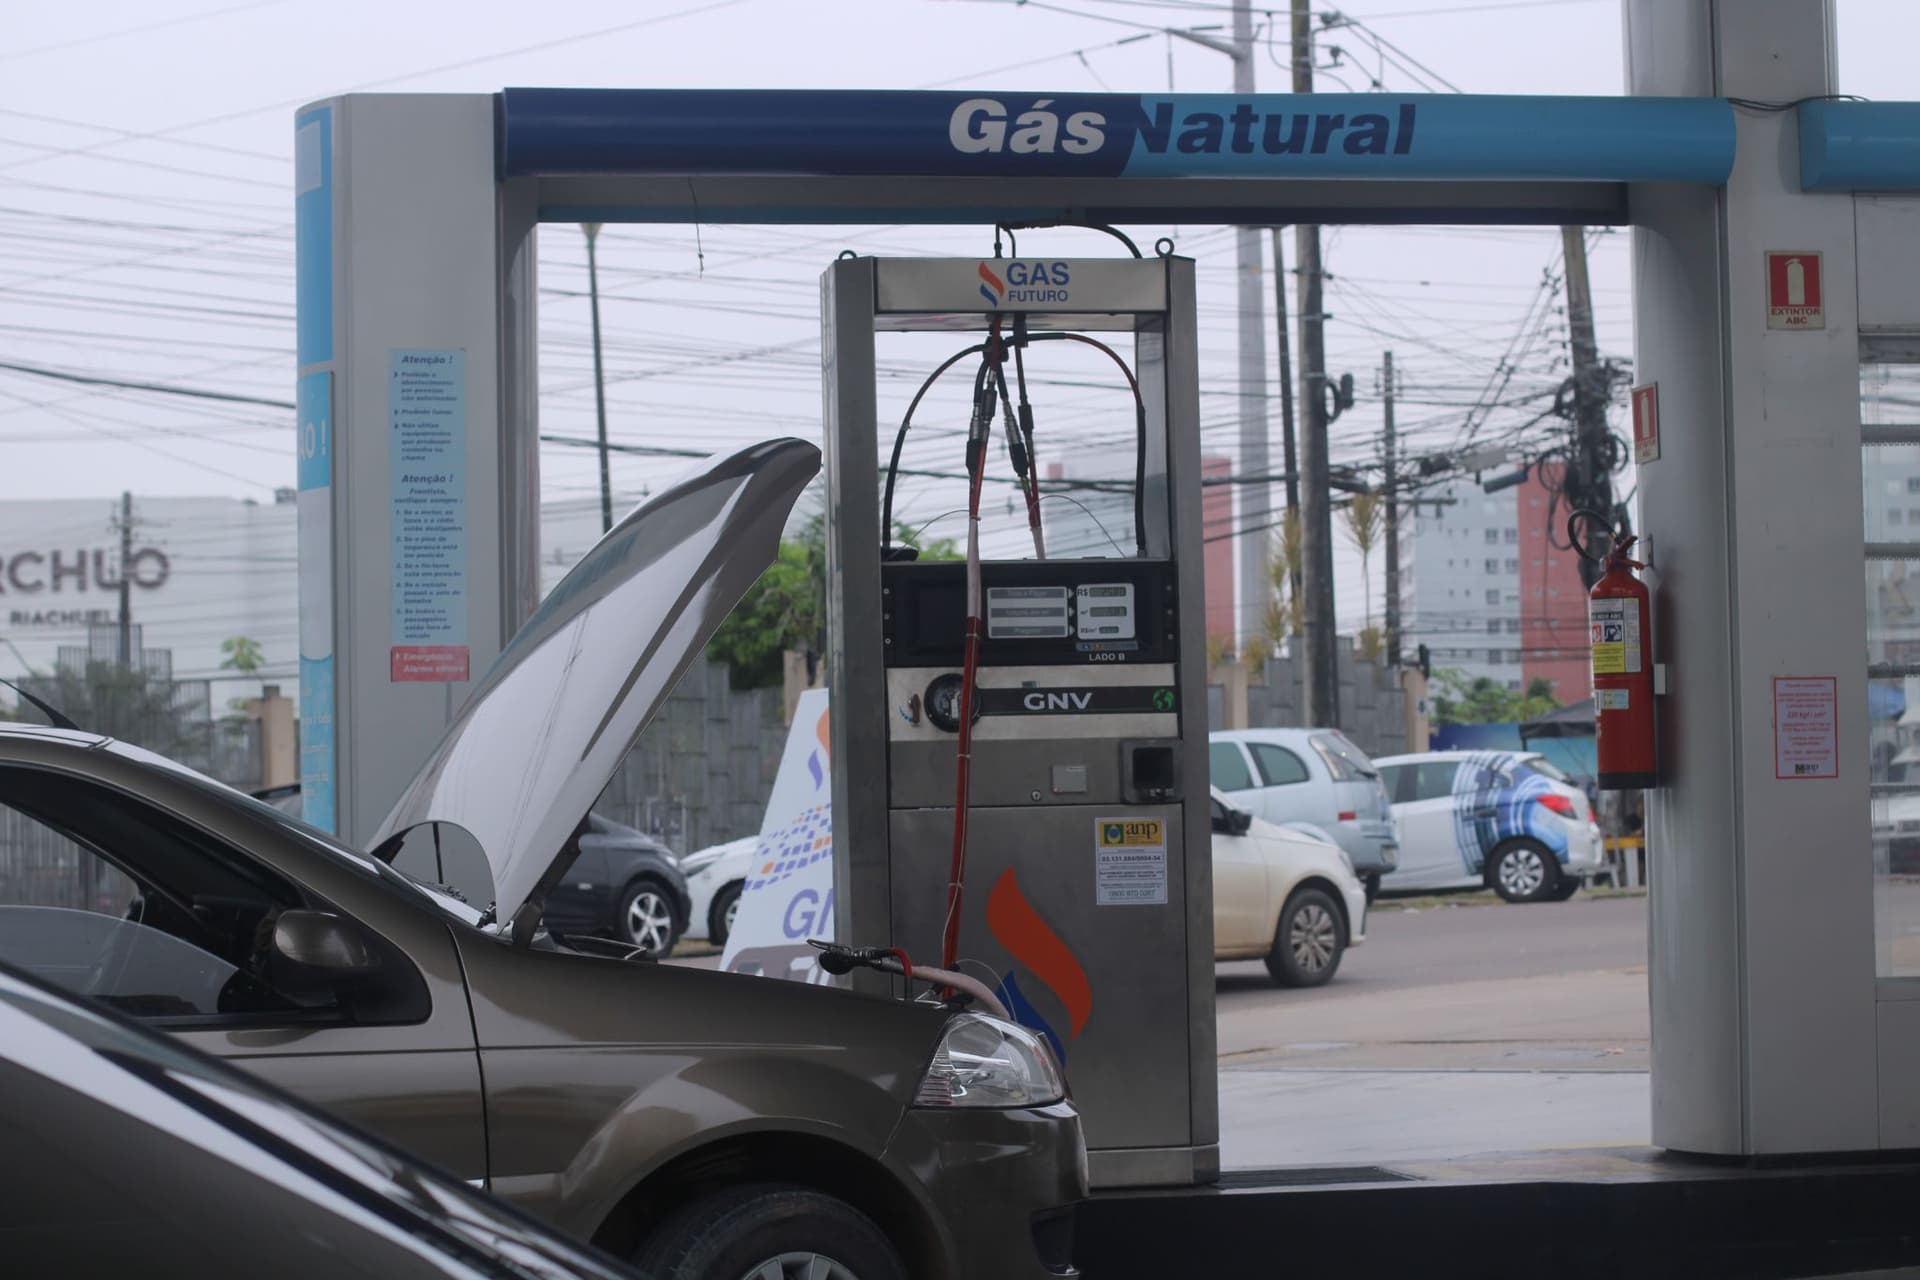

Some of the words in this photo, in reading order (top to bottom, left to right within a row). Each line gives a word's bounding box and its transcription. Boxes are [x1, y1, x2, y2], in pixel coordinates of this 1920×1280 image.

[949, 98, 1106, 155] Gás
[1131, 102, 1417, 155] Natural
[1006, 262, 1070, 286] GAS
[1008, 290, 1069, 302] FUTURO
[1770, 307, 1821, 316] EXTINTOR
[1785, 316, 1808, 325] ABC
[401, 355, 446, 366] Atenção
[401, 474, 446, 485] Atenção
[0, 548, 170, 594] CHLO
[1088, 653, 1116, 661] LADO
[1118, 652, 1126, 661] B
[1023, 692, 1093, 711] GNV
[1126, 822, 1158, 839] anp
